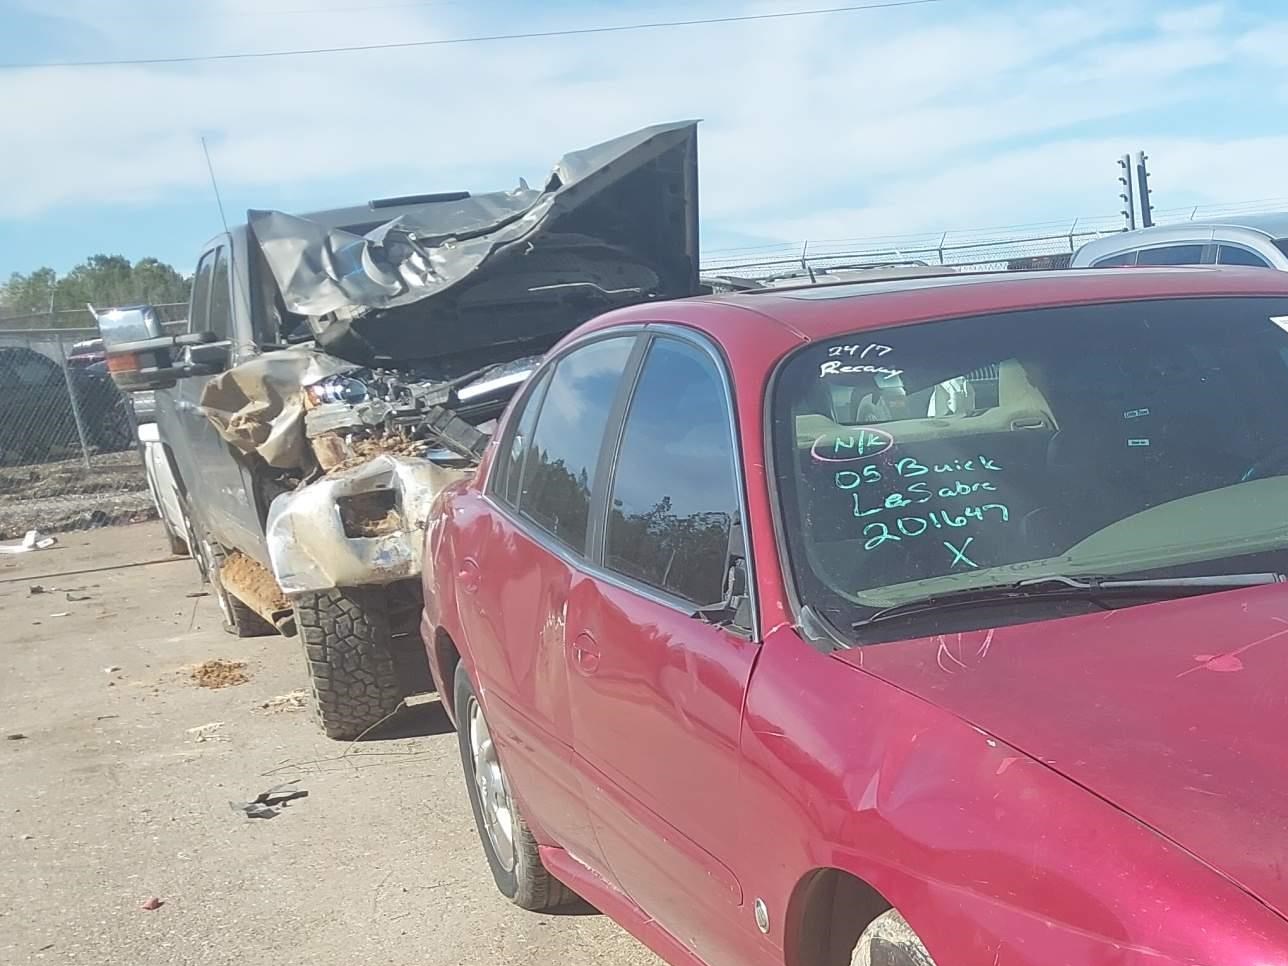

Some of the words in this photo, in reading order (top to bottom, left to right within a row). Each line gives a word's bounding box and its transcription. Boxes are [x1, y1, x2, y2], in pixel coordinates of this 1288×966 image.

[828, 344, 893, 359] 24/7
[835, 465, 882, 489] 05
[894, 456, 1003, 478] Buick
[943, 537, 979, 568] X
